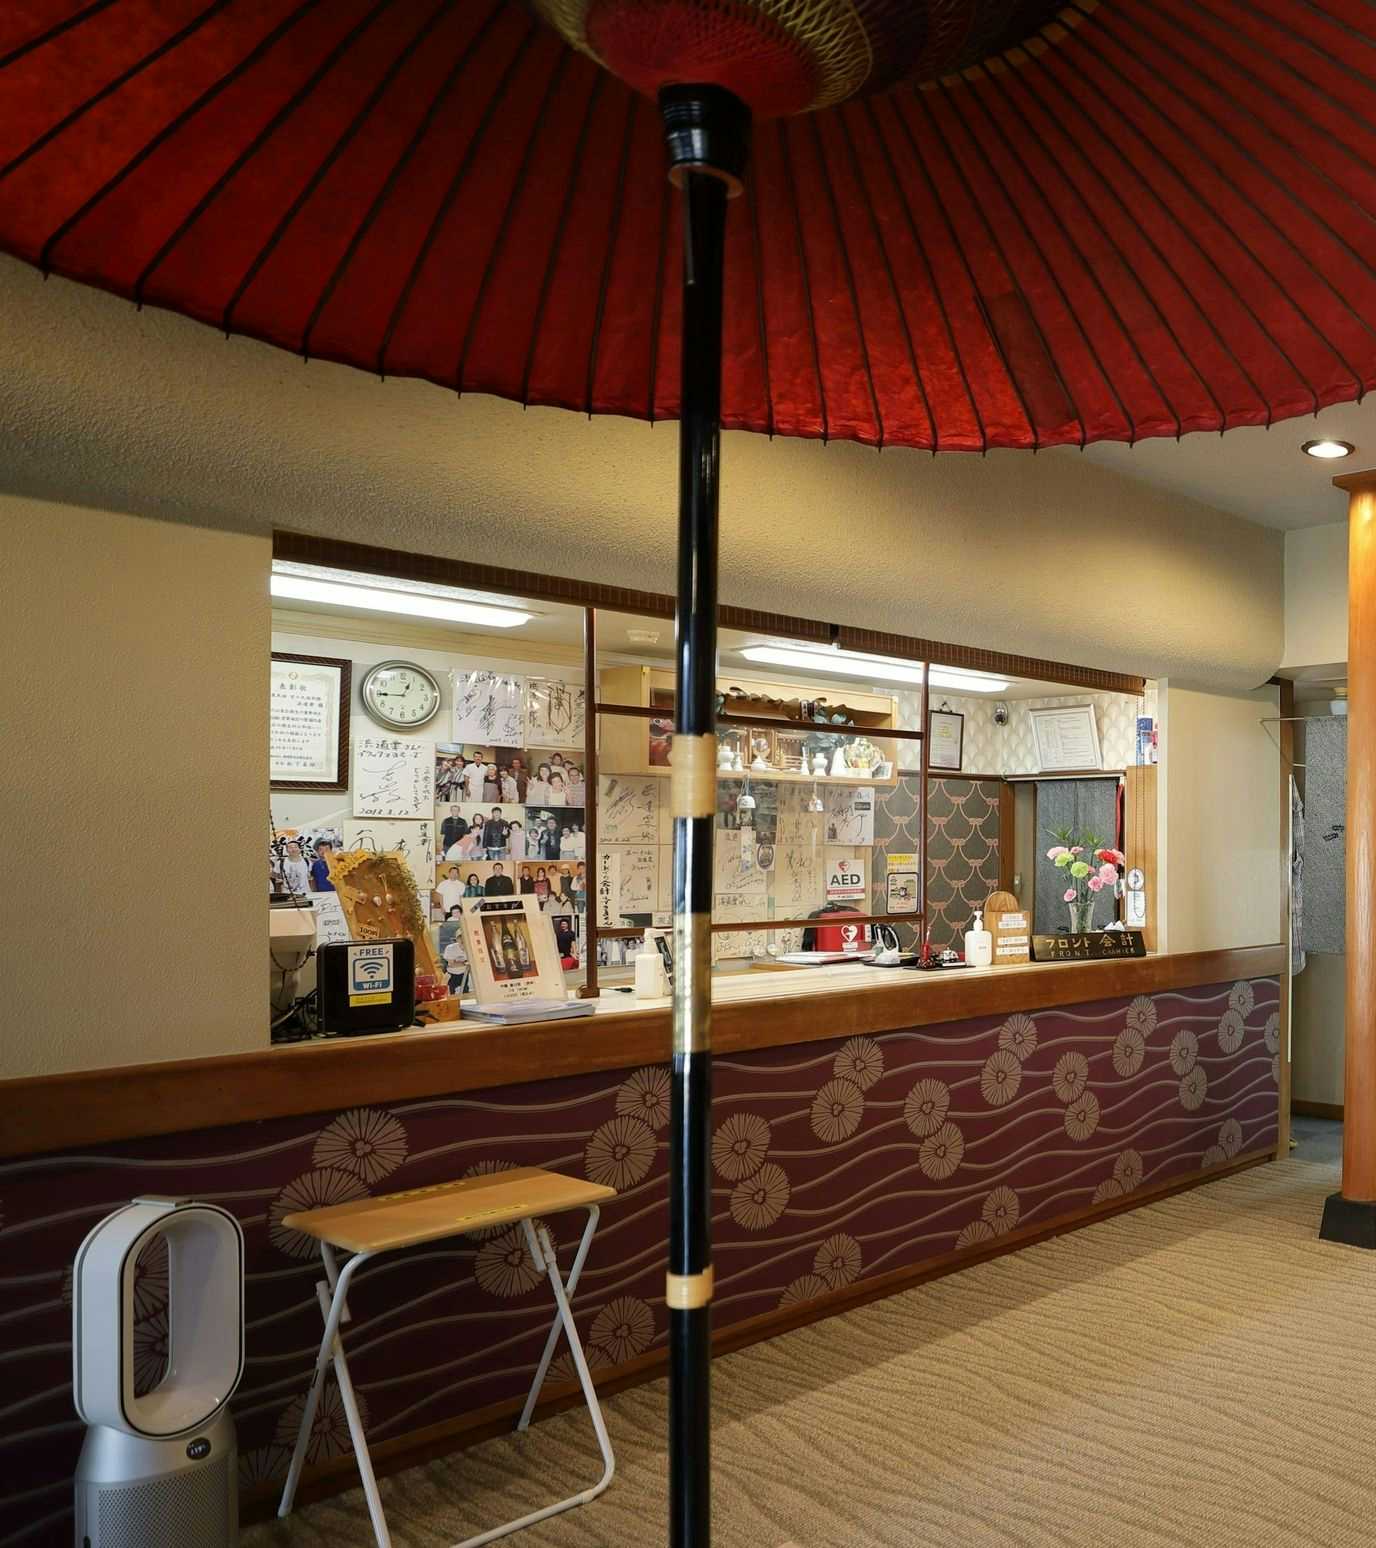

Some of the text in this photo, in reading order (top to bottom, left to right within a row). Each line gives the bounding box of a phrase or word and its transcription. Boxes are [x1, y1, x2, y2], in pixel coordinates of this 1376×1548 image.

[830, 873, 861, 886] AED
[1046, 933, 1134, 949] フロント 会計
[360, 947, 384, 957] FREE
